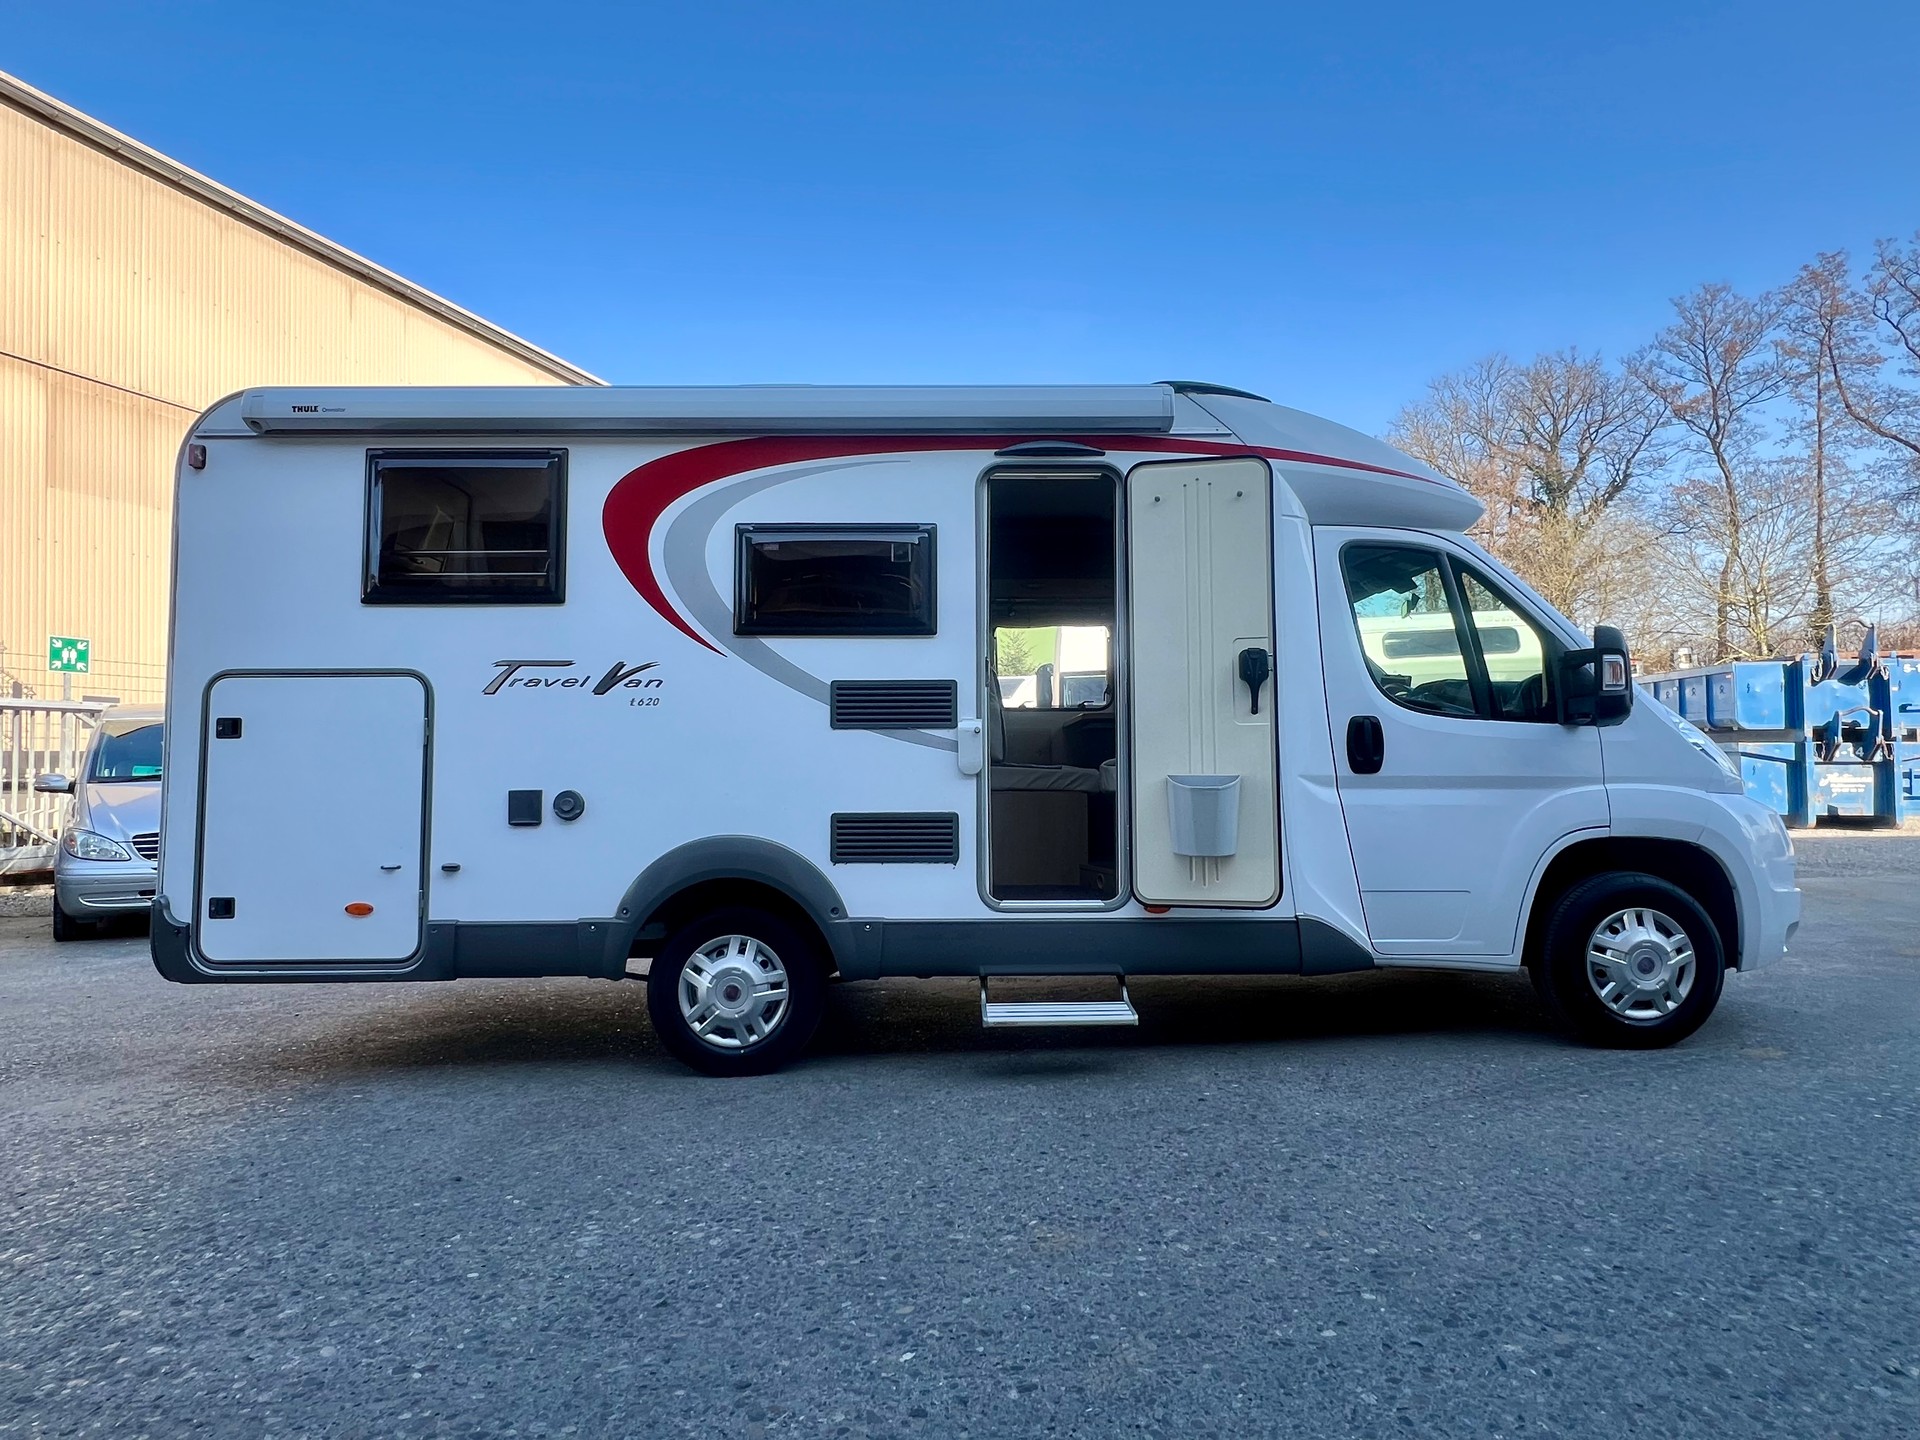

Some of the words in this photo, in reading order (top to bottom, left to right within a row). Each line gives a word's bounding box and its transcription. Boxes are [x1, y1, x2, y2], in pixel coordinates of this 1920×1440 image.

[291, 405, 319, 413] THULE
[482, 659, 592, 695] Travel
[591, 661, 664, 695] Van
